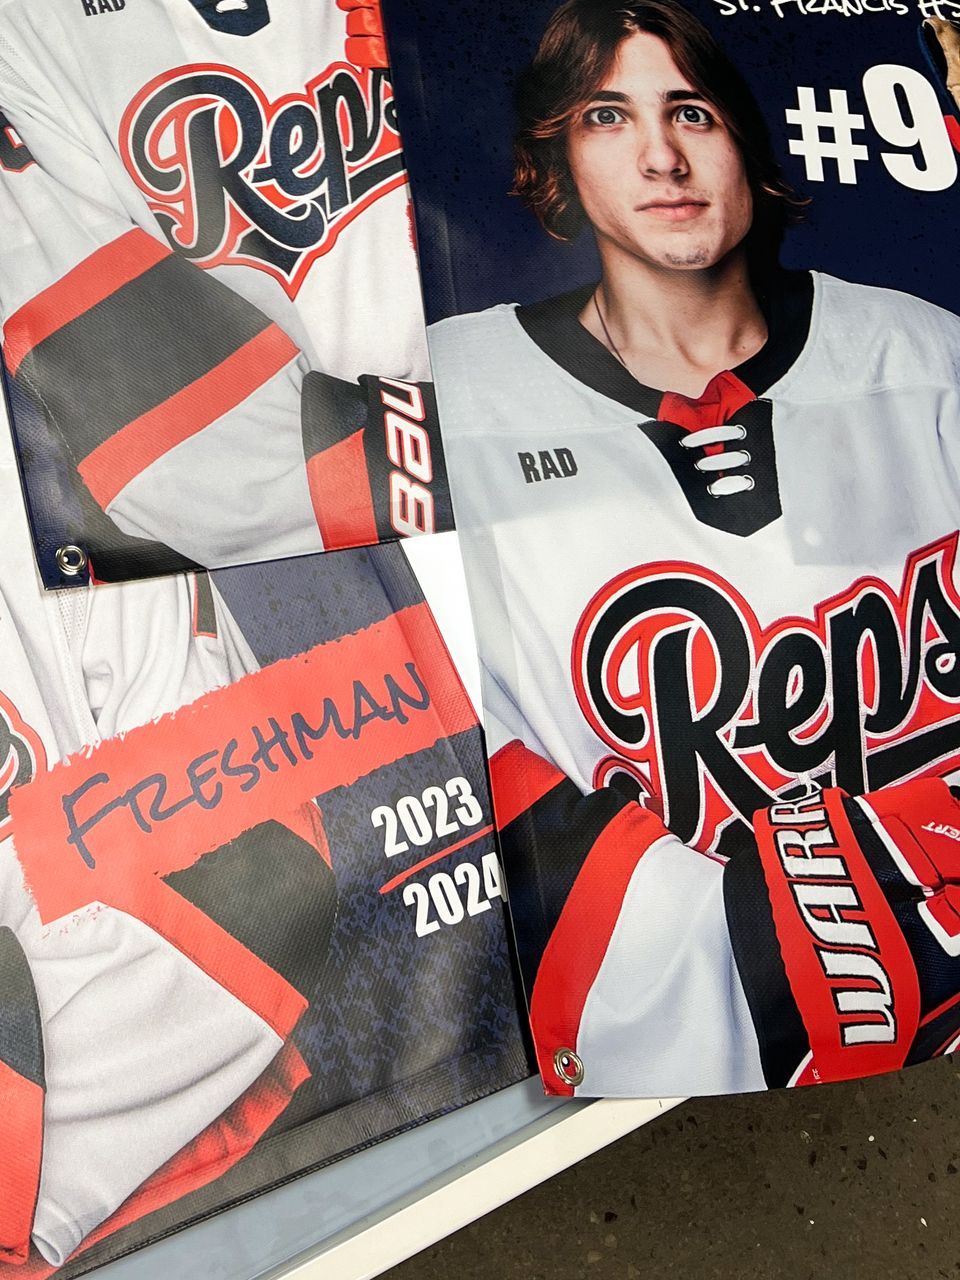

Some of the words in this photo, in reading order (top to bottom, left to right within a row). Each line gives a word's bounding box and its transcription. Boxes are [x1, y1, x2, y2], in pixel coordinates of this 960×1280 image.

[785, 64, 958, 192] #9
[517, 447, 579, 484] RAD
[61, 662, 431, 871] FRESHMAN
[371, 776, 483, 858] 2023
[402, 851, 508, 938] 2024
